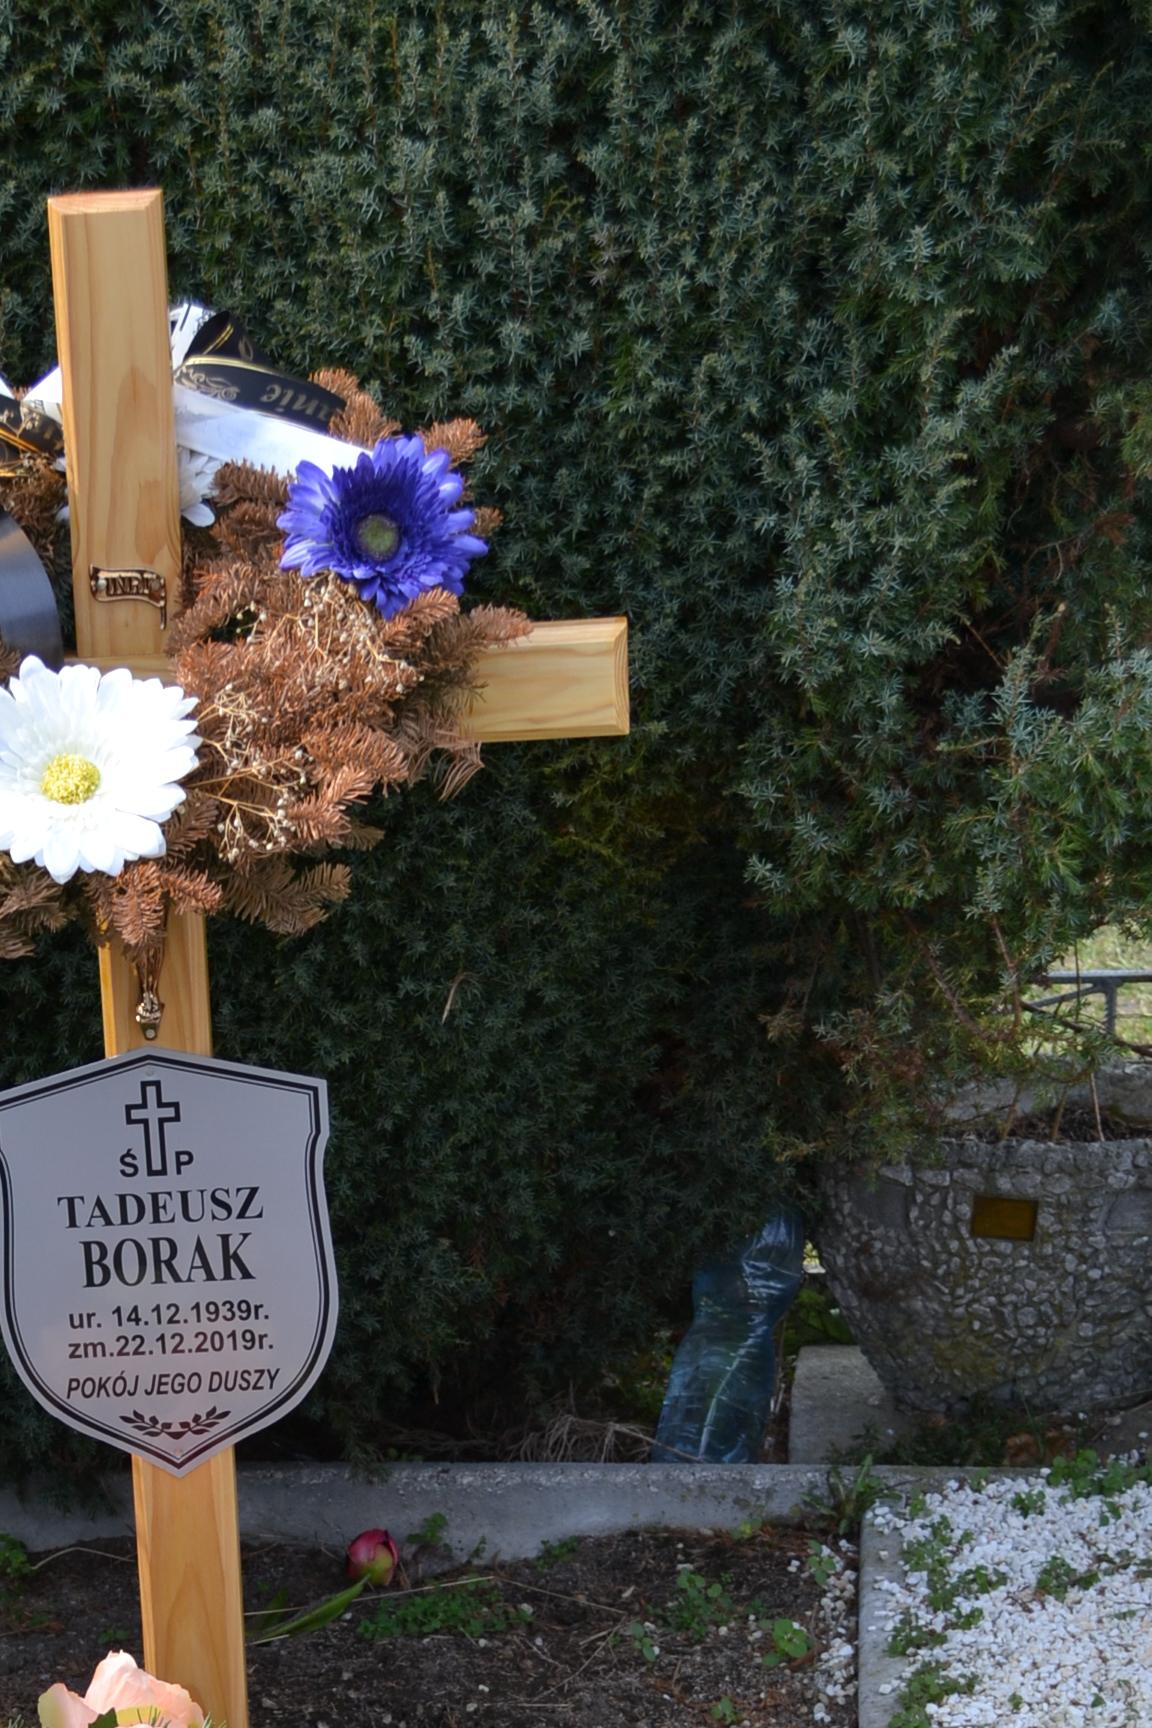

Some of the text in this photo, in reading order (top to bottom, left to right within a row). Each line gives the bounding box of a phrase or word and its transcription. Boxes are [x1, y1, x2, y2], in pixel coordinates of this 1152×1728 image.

[119, 1148, 194, 1178] Ś P
[57, 1186, 264, 1229] TADEUSZ
[79, 1232, 256, 1288] BORAK
[68, 1299, 270, 1329] ur. 14.12.1939r.
[66, 1368, 280, 1400] POKÓJ JEGO DUSZY
